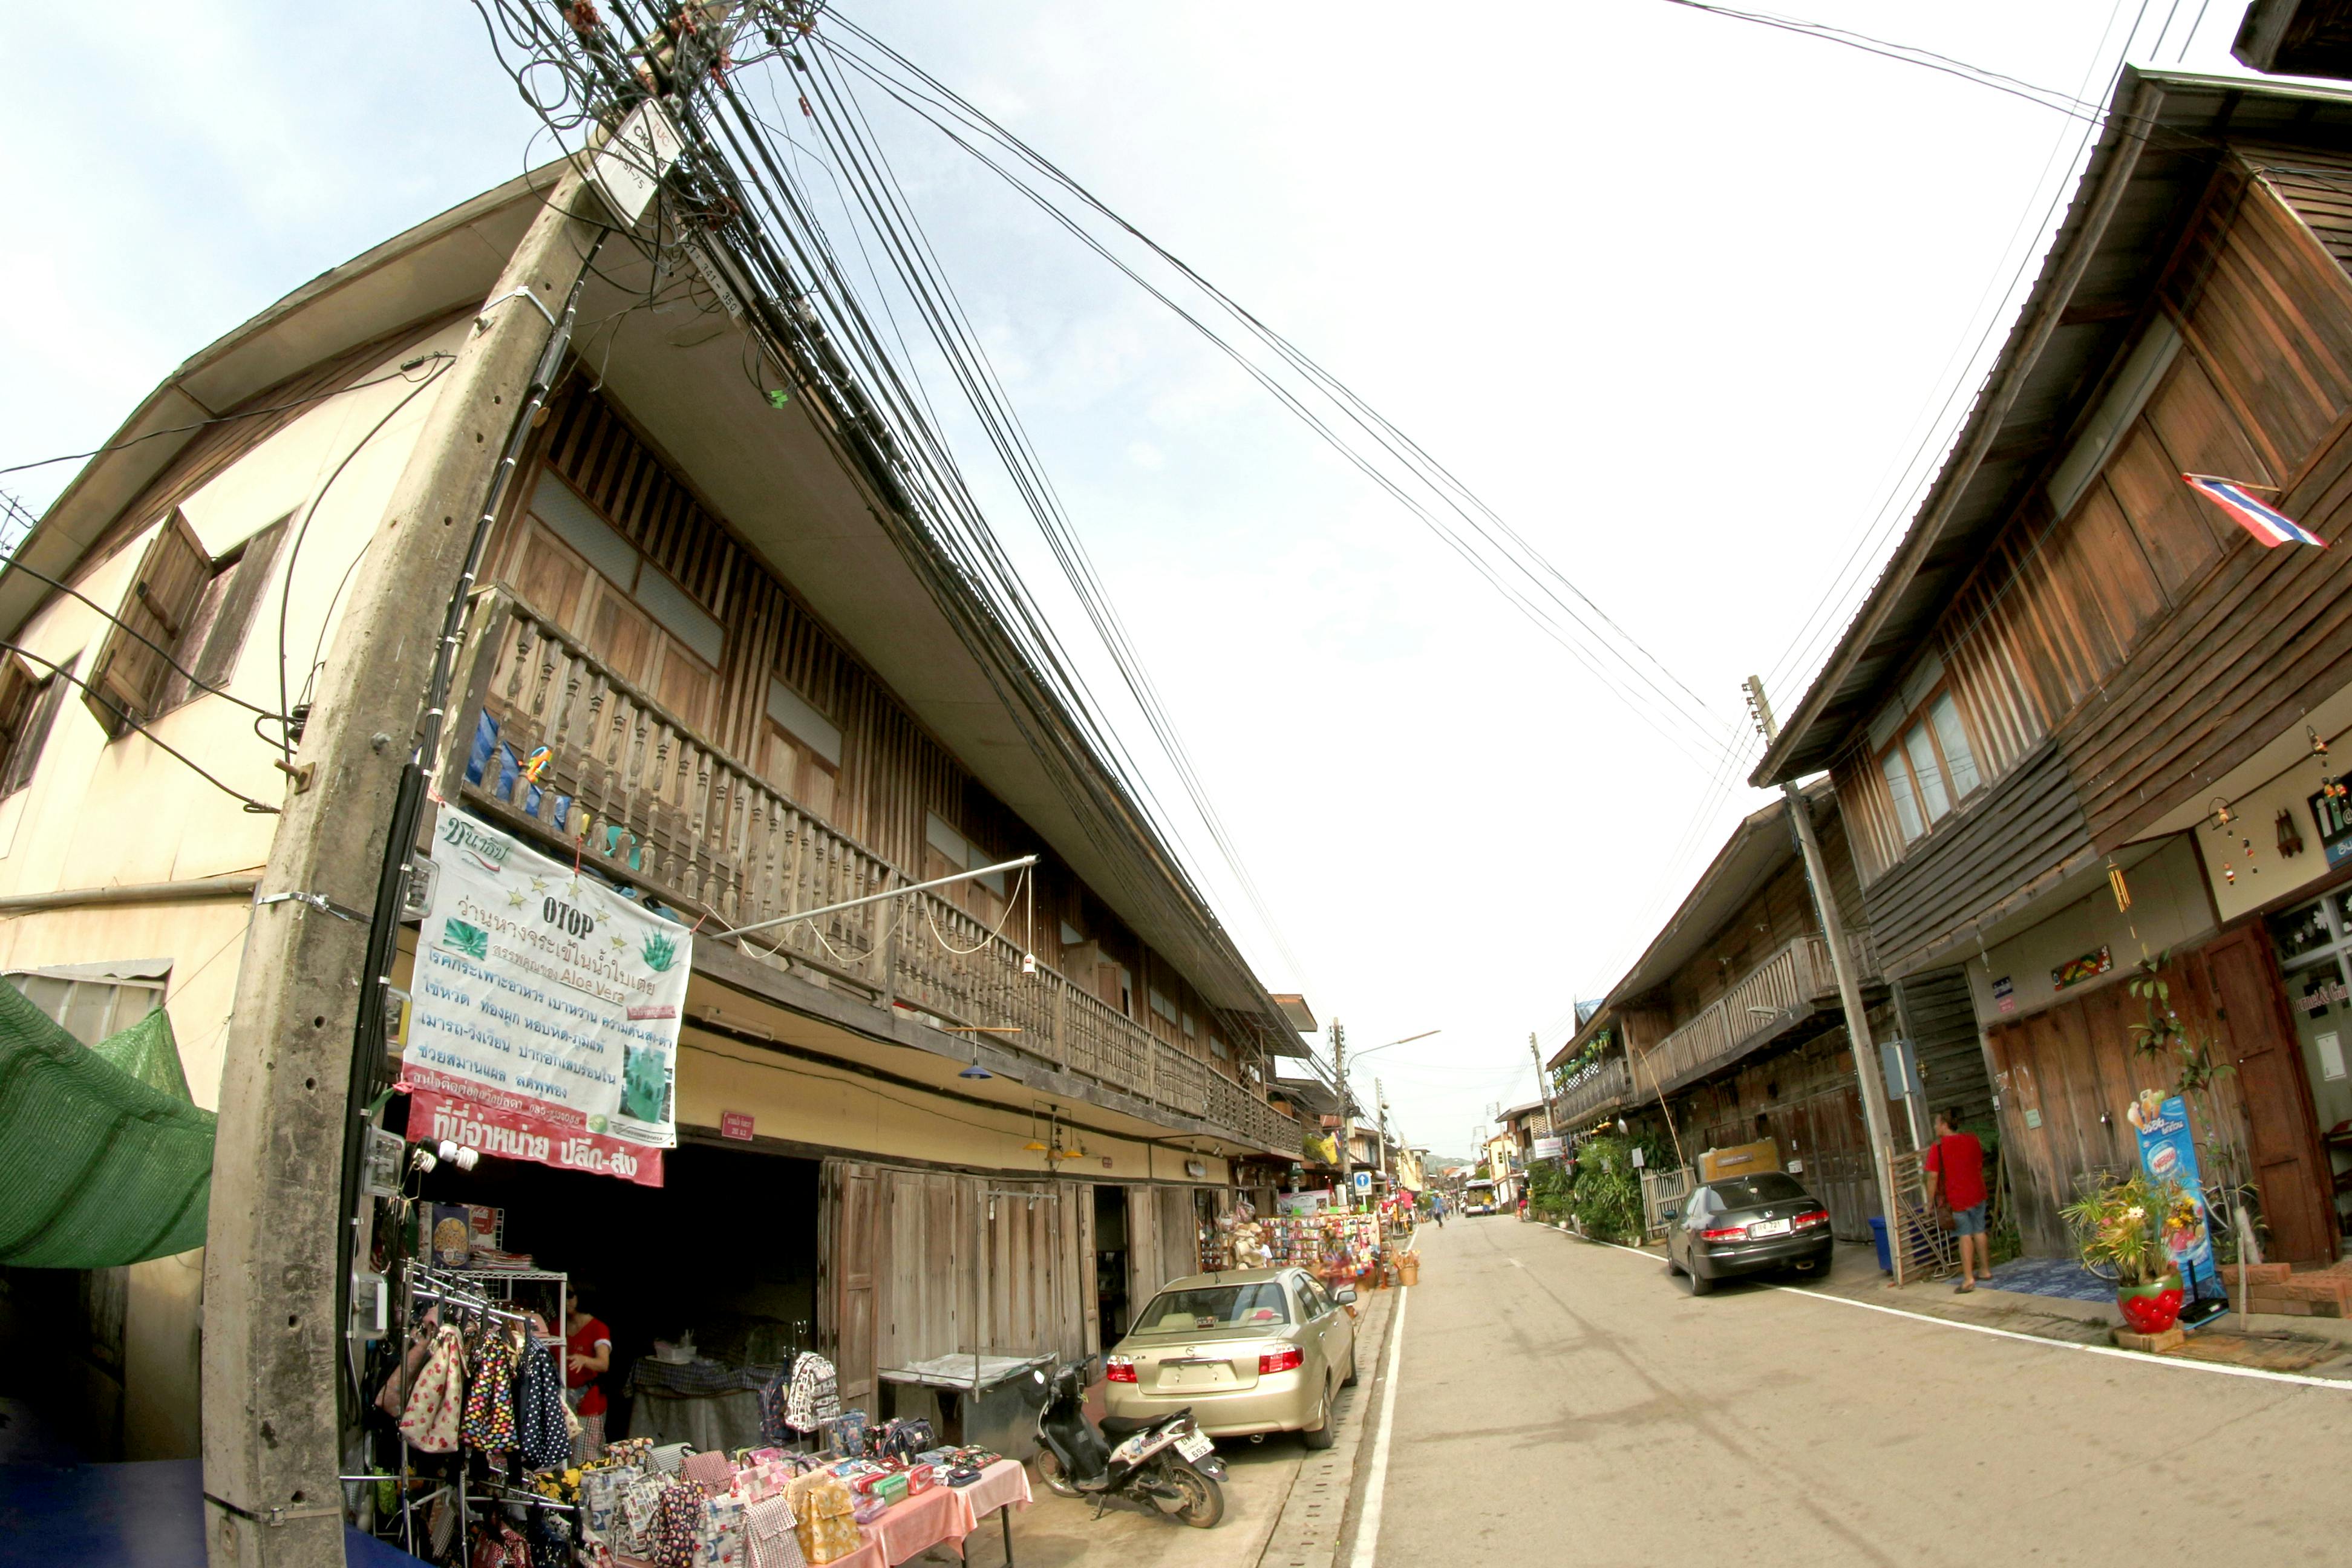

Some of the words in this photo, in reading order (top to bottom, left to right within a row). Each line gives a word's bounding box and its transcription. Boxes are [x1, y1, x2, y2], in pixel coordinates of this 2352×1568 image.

[652, 120, 670, 146] TUC
[702, 263, 716, 282] 341
[722, 292, 737, 311] 350
[543, 896, 595, 941] OTOP
[458, 895, 656, 996] ว่านหางจระเข้ในน้ำใบเตย
[429, 949, 544, 1003] โรคกระเพาะอาหาร
[548, 996, 598, 1024] เบาหวาน
[560, 968, 592, 990] Aloe
[596, 980, 625, 1003] Vera
[417, 1041, 507, 1082] ช่วยสมานแผล
[433, 1099, 550, 1160] ที่นี่จำหน่าย
[560, 1137, 638, 1177] ปลีก-ส่ง
[1191, 1446, 1208, 1459] 693
